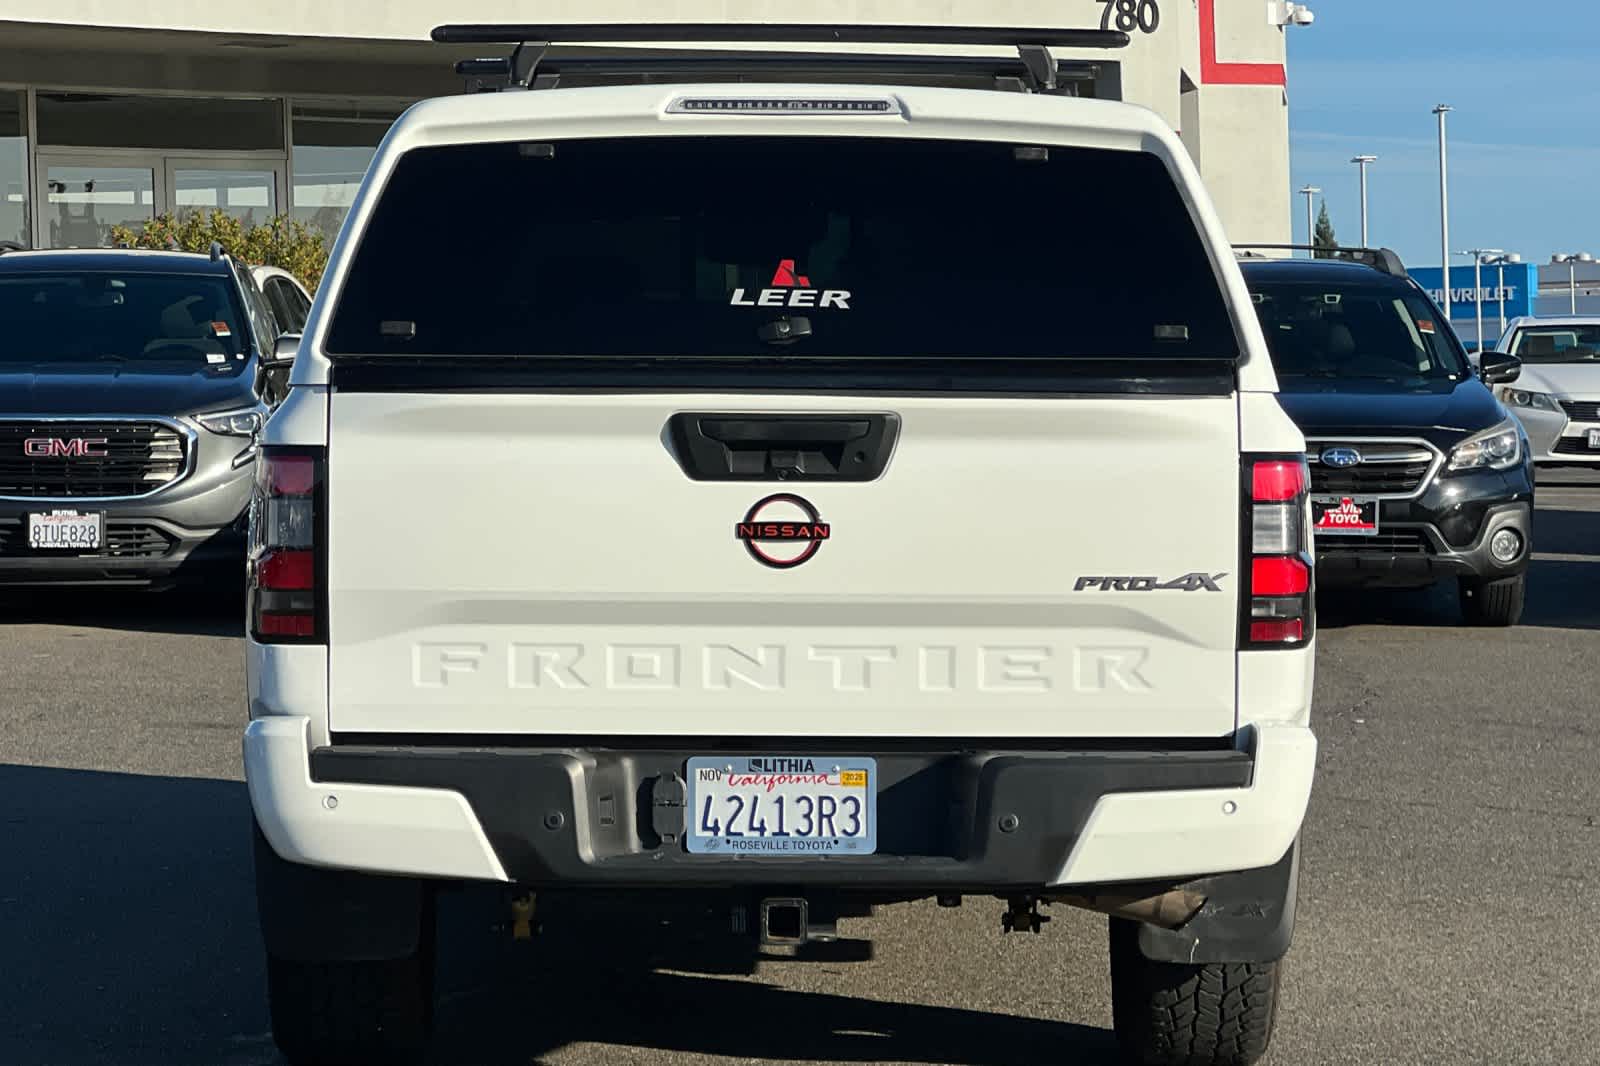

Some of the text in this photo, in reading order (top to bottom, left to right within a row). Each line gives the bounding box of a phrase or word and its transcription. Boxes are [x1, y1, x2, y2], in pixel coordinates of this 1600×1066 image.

[1095, 0, 1160, 34] 780
[730, 287, 851, 309] LEER
[24, 437, 109, 457] GMC
[33, 524, 97, 542] 8TUE828
[740, 524, 829, 538] NISSAN
[411, 641, 1155, 693] FRONTIER
[700, 769, 722, 781] NOV
[764, 759, 815, 773] LITHIA
[728, 772, 841, 792] California
[701, 795, 861, 837] 42413R3
[732, 840, 833, 850] ROSEVILLE TOYOTA
